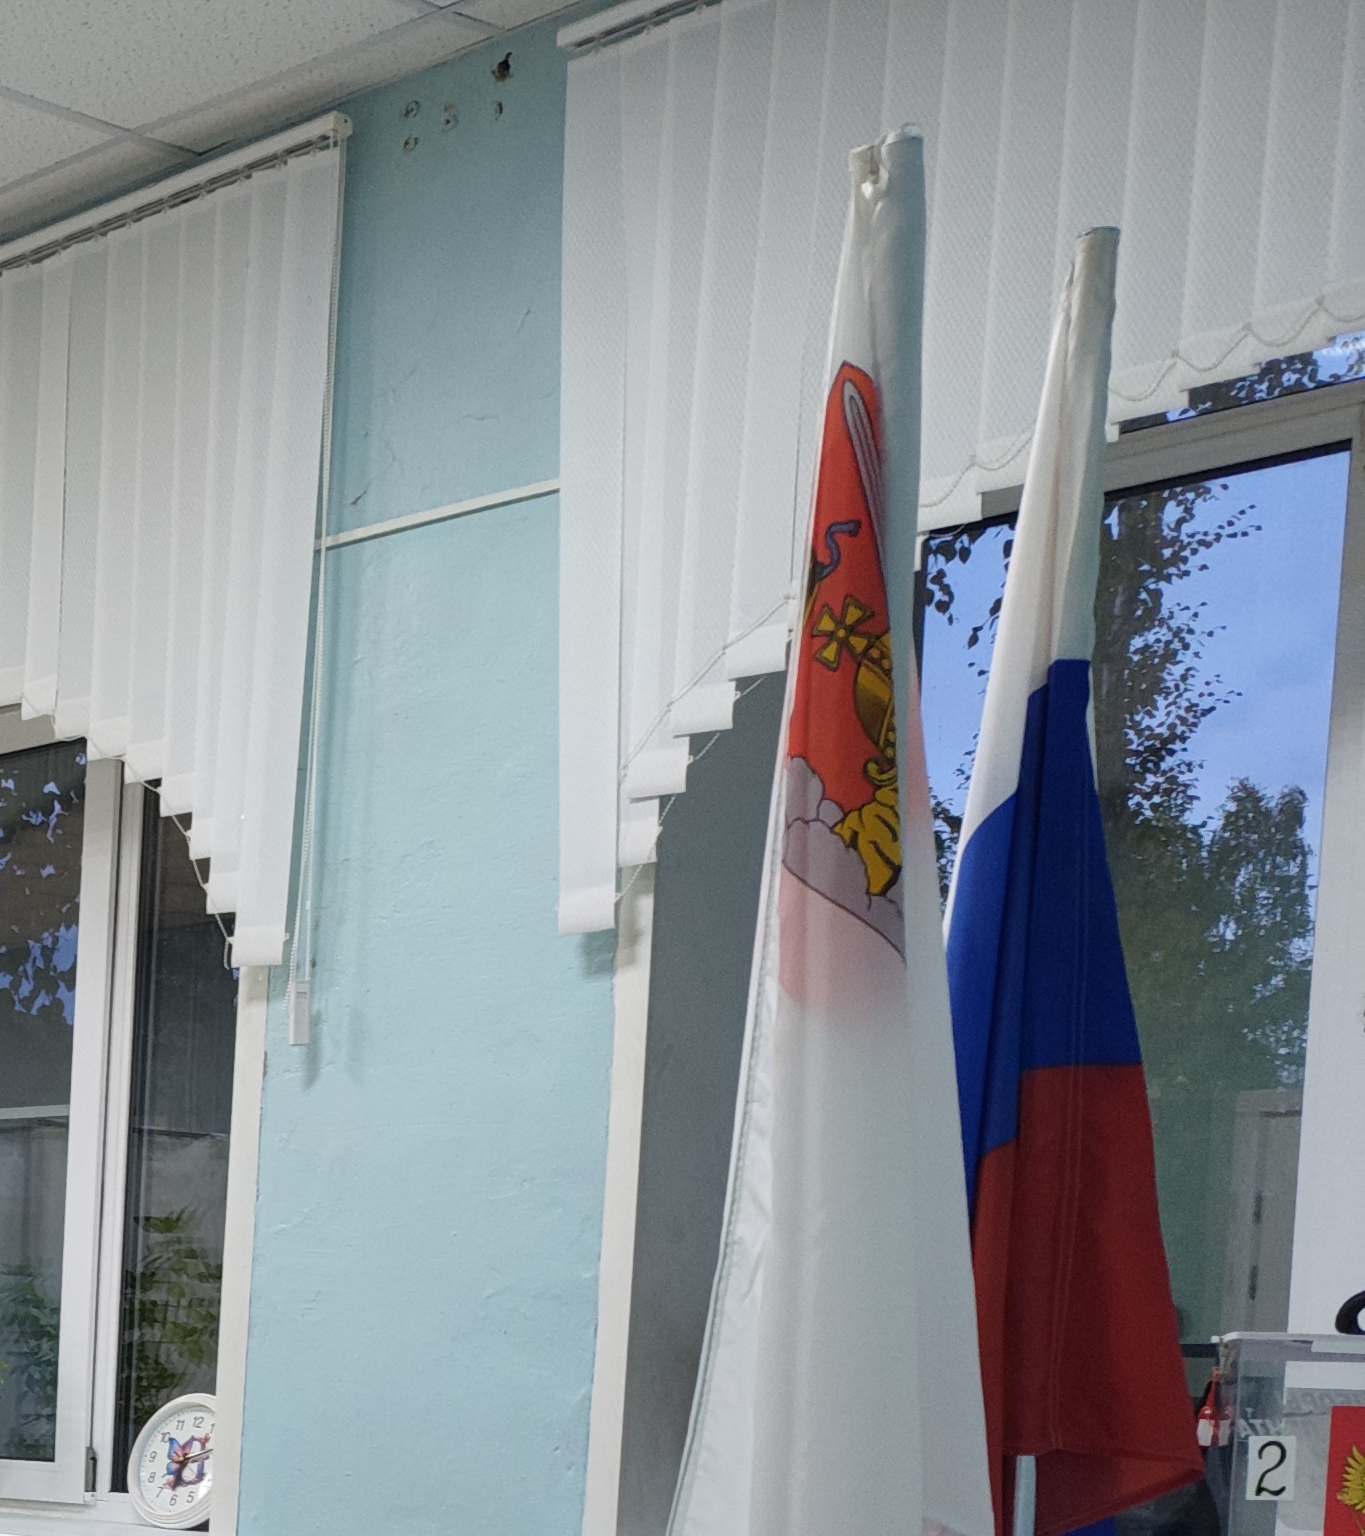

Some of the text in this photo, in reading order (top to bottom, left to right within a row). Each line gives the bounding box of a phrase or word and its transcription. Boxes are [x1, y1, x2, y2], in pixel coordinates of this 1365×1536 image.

[175, 1419, 186, 1431] 11
[192, 1416, 205, 1429] 12
[160, 1431, 171, 1443] 10
[149, 1450, 158, 1463] 9
[1255, 1440, 1287, 1497] 2
[147, 1471, 157, 1484] 8
[155, 1486, 165, 1499] 7
[185, 1491, 196, 1504] 5
[169, 1494, 179, 1507] 6
